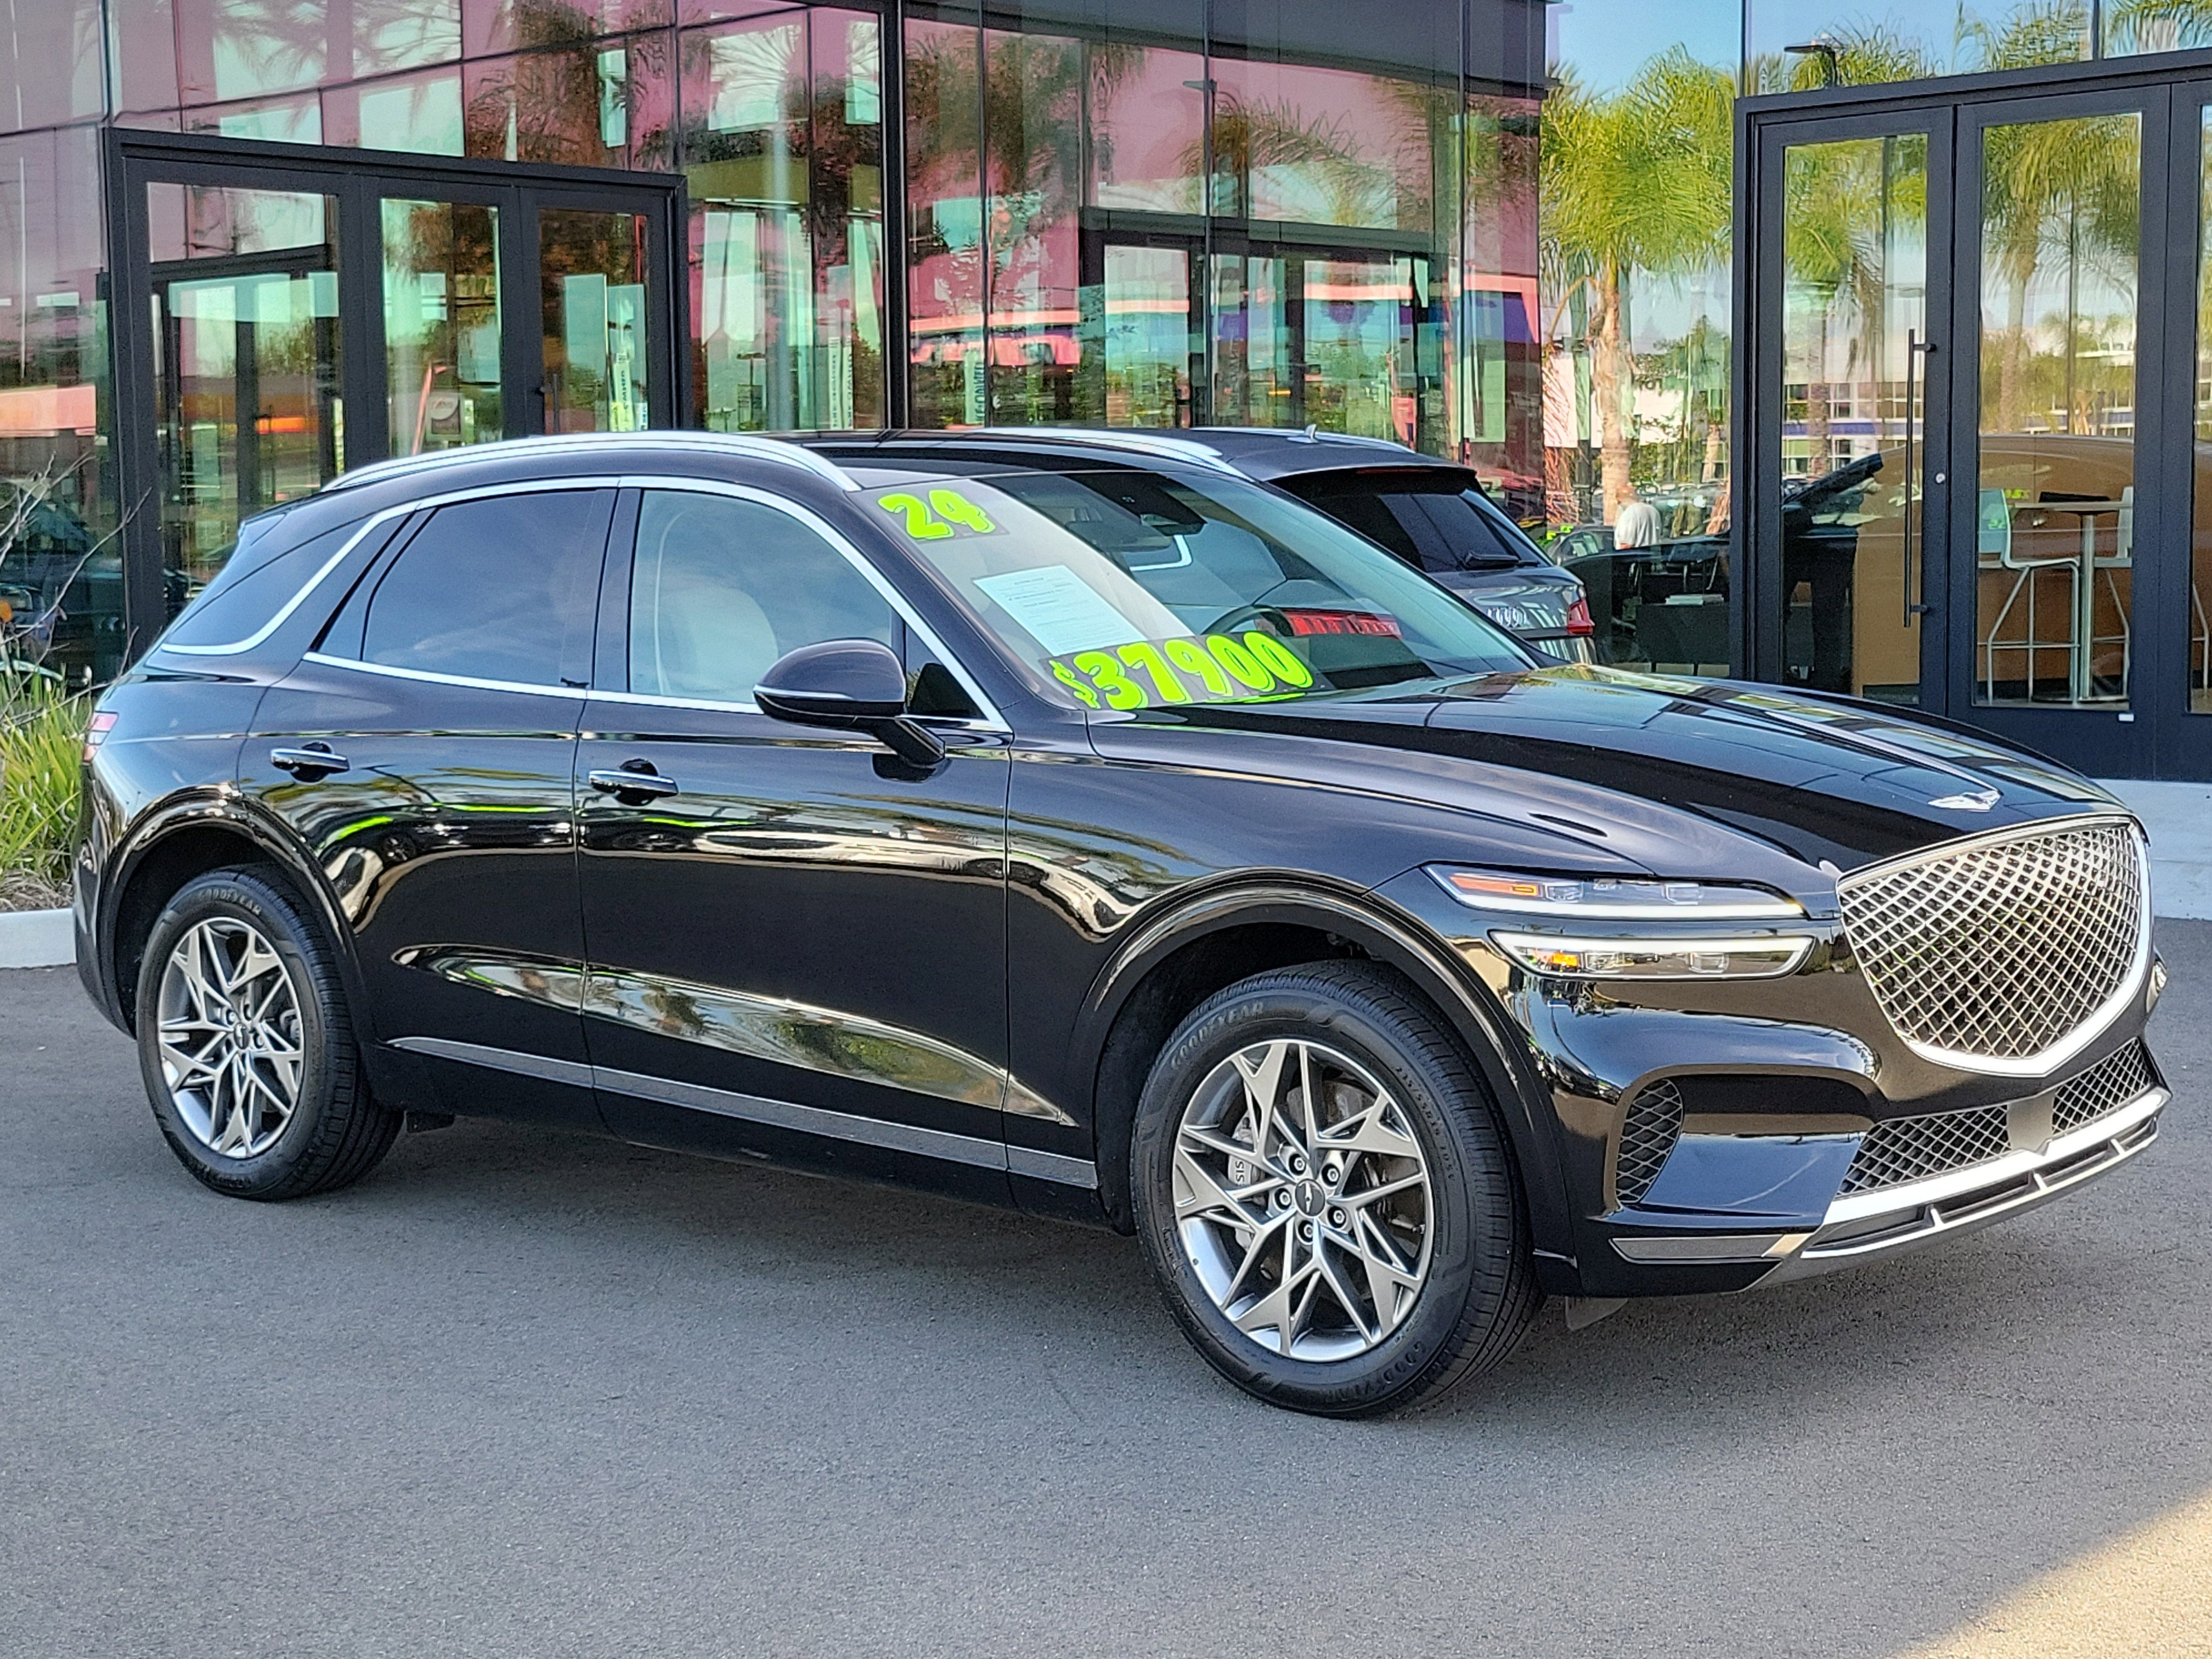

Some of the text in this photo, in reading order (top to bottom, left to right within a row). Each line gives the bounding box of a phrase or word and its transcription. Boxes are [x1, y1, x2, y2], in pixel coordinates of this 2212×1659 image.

[878, 489, 997, 540] 24
[1049, 631, 1313, 710] $37900
[1171, 1001, 1263, 1070] GOODYEAR
